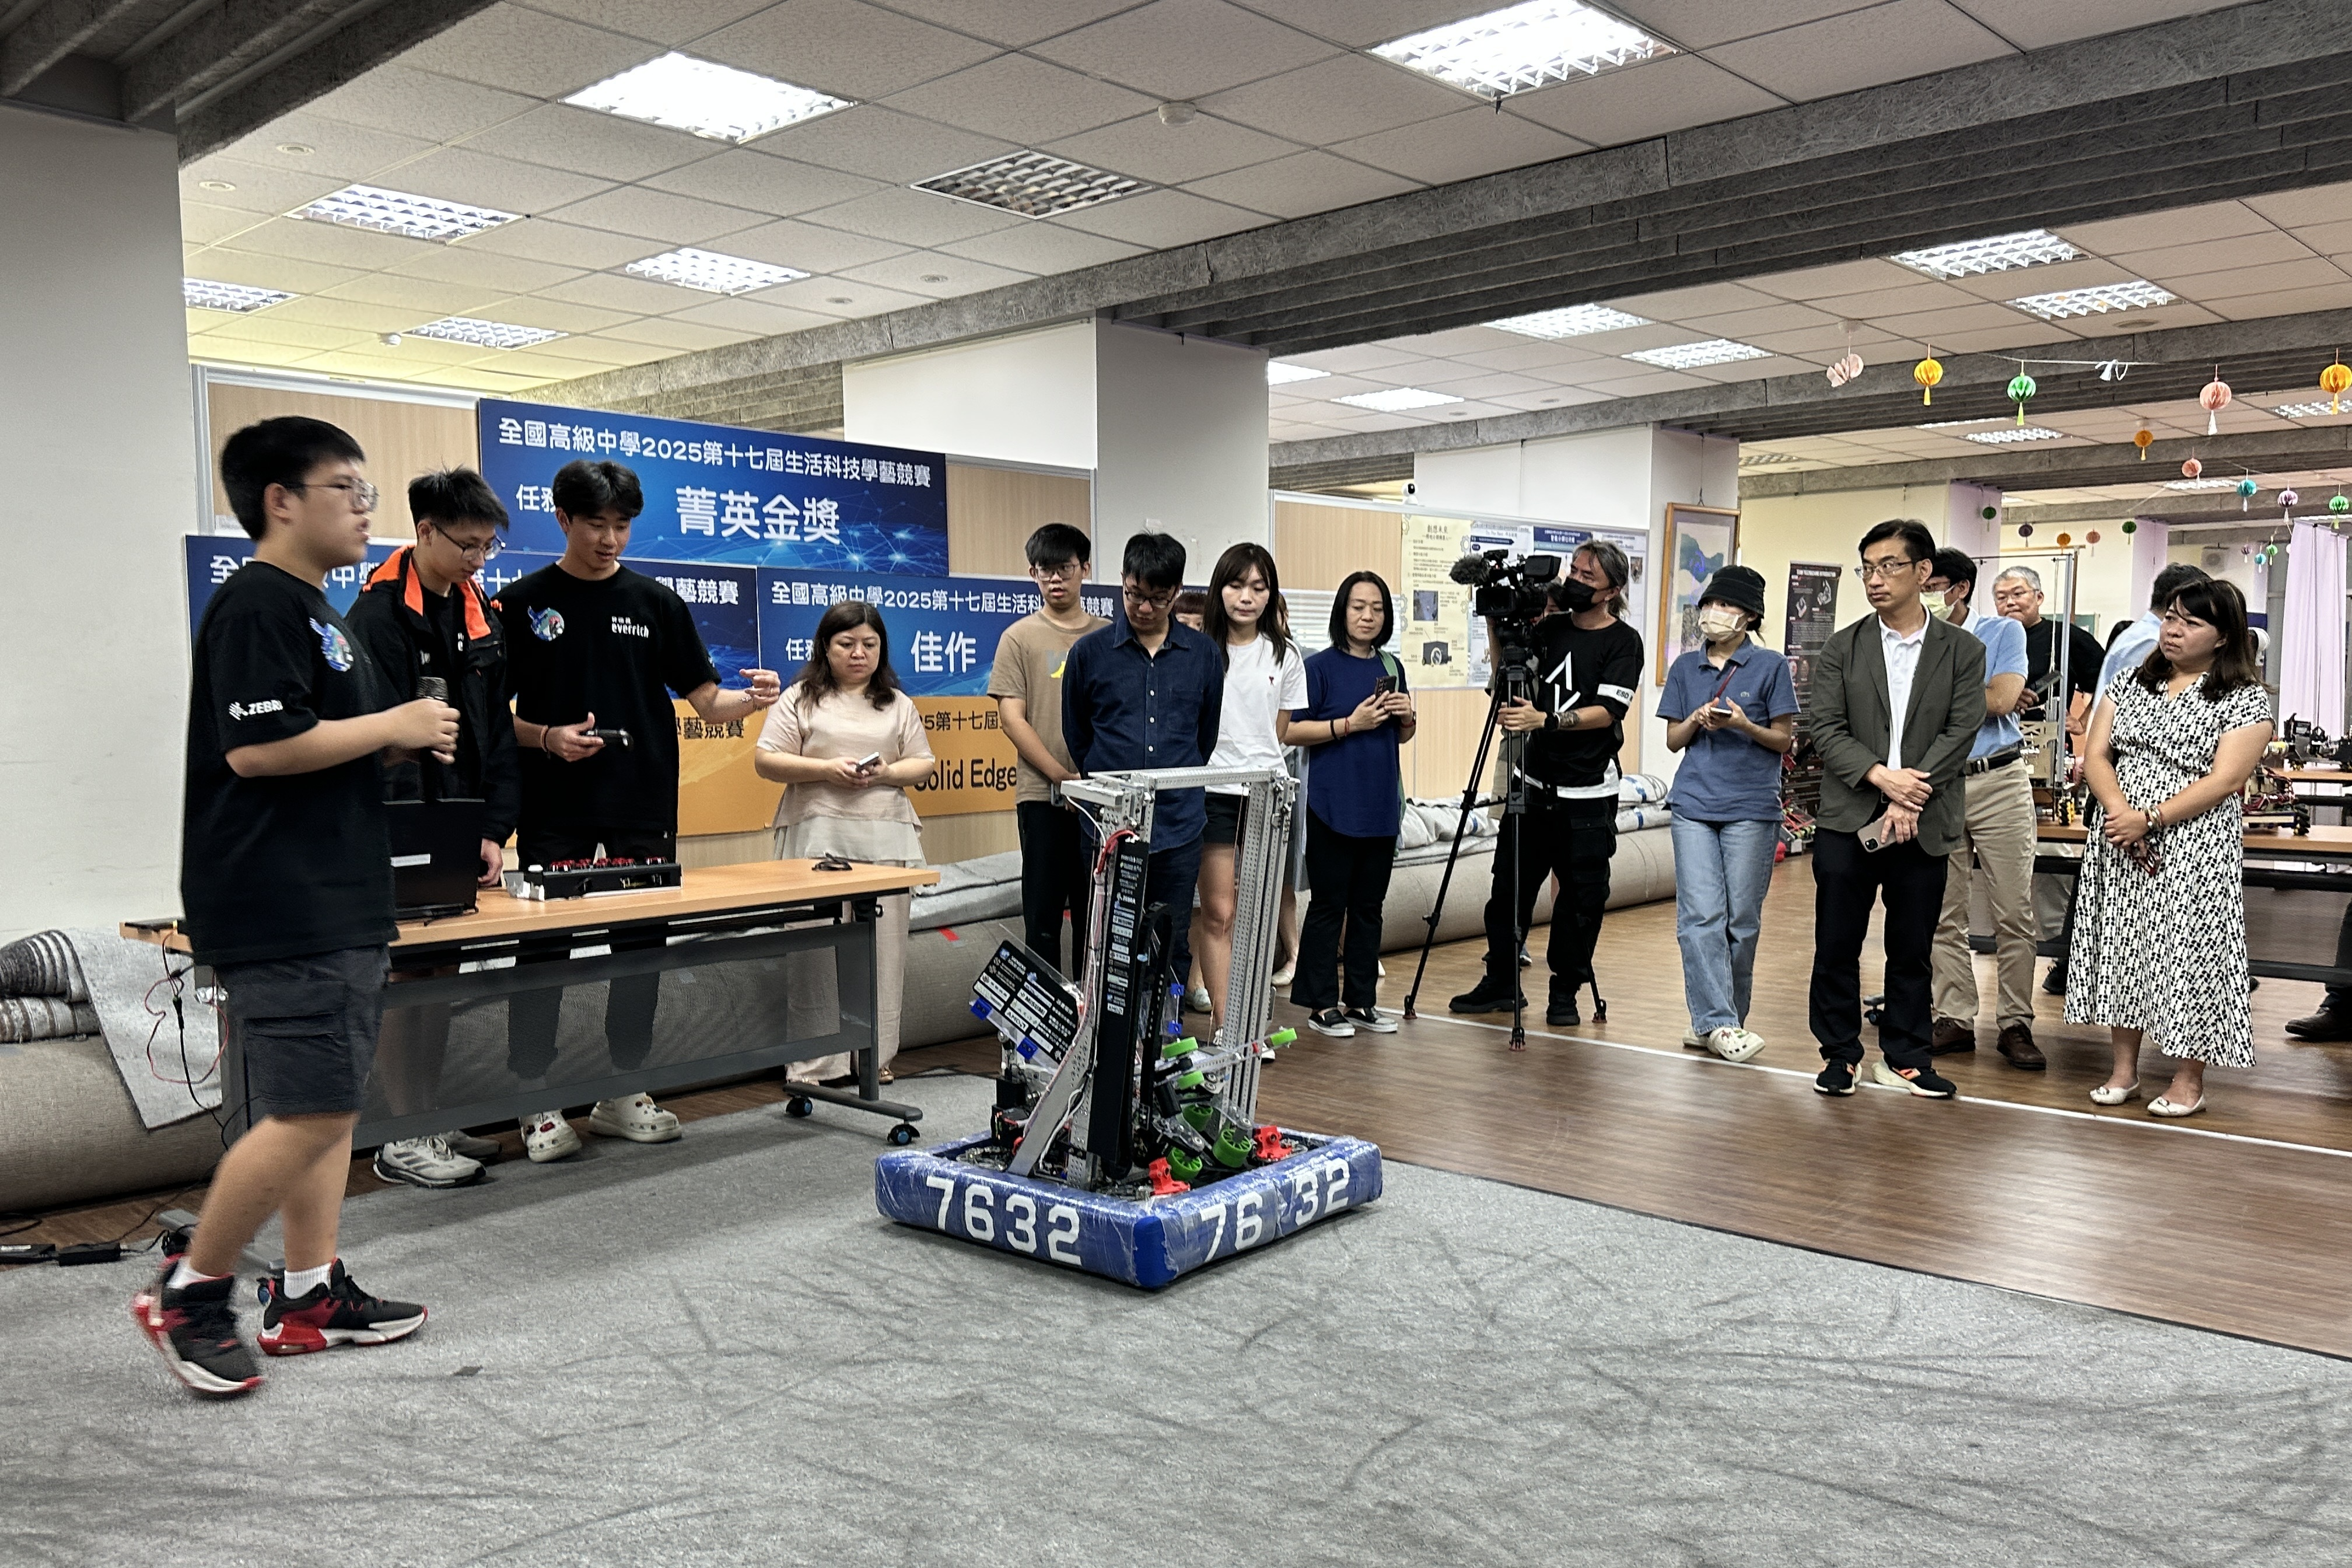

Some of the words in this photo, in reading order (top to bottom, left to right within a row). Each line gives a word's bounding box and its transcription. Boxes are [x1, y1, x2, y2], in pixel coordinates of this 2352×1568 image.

[676, 485, 841, 545] 菁英金獎
[611, 623, 649, 638] everrich
[911, 630, 977, 673] 佳作
[971, 757, 1017, 792] Edge
[926, 1175, 1082, 1266] 7632
[1199, 1158, 1350, 1262] 7632
